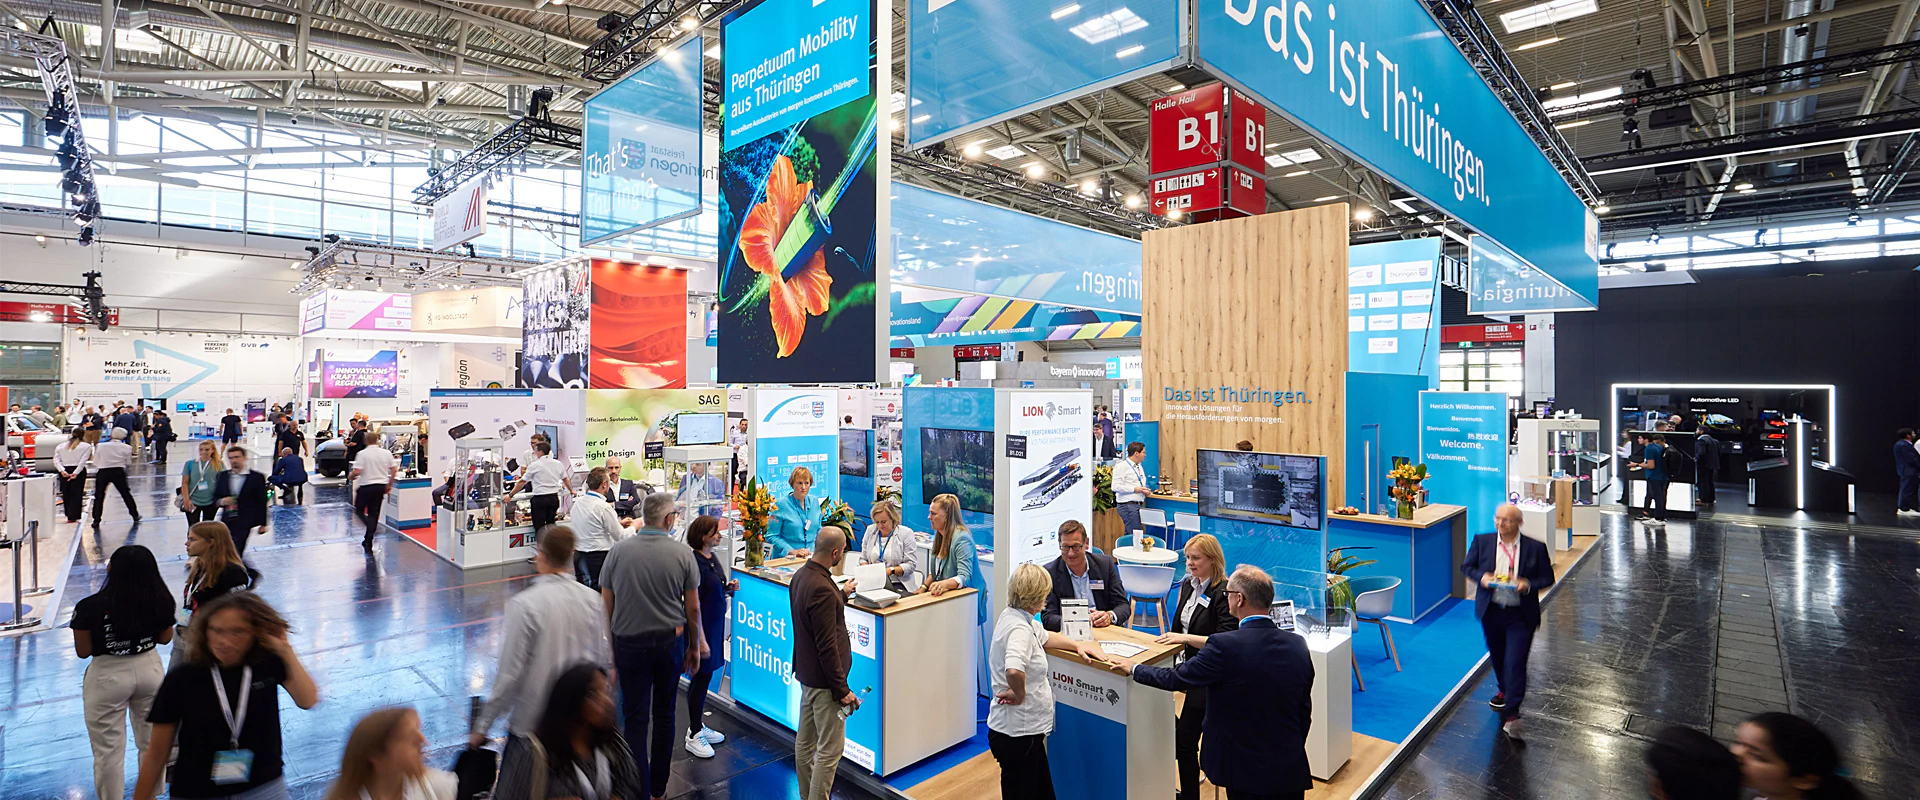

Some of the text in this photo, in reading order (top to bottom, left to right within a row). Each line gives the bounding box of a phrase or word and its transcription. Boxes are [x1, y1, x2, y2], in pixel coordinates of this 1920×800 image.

[732, 14, 858, 92] Perpetuum Mobility
[731, 64, 820, 118] aus Thüringen
[779, 107, 787, 116] von
[824, 87, 832, 97] aus
[832, 78, 858, 94] Thüringen.
[1155, 93, 1196, 111] Halle Hall
[1328, 4, 1369, 118] ist
[1376, 51, 1490, 206] Thüringen.
[1178, 111, 1218, 151] B1
[1246, 118, 1264, 157] B1
[1050, 366, 1105, 377] bayern innovativ
[699, 395, 720, 404] SAG
[1164, 386, 1312, 406] Das ist Thüringen.
[1023, 406, 1081, 416] LION Smart
[1176, 413, 1238, 422] Herausforderungen
[1200, 404, 1230, 412] Lösungen
[1440, 440, 1484, 449] Welcome.
[1468, 433, 1499, 441] 热烈欢迎
[1427, 453, 1468, 462] Välkommen.
[738, 601, 786, 641] Das ist
[737, 636, 792, 685] Thüring
[1053, 672, 1103, 694] LION Smart
[1053, 682, 1104, 703] PRODUCTION
